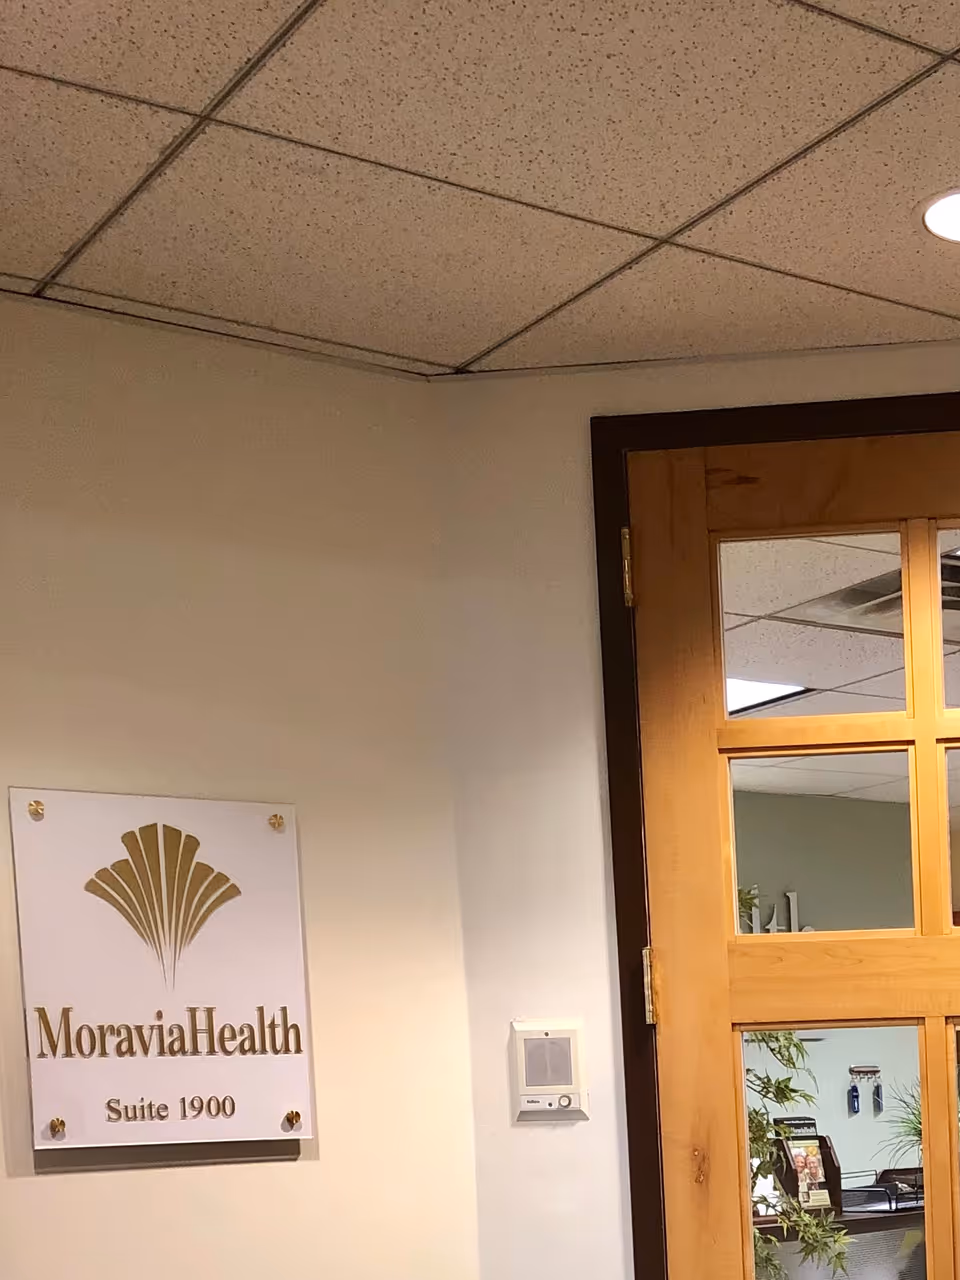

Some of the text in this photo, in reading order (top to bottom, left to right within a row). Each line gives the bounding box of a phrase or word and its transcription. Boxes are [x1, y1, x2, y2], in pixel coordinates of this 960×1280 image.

[33, 1005, 303, 1059] MoraviaHealth
[105, 1095, 236, 1123] Suite 1900
